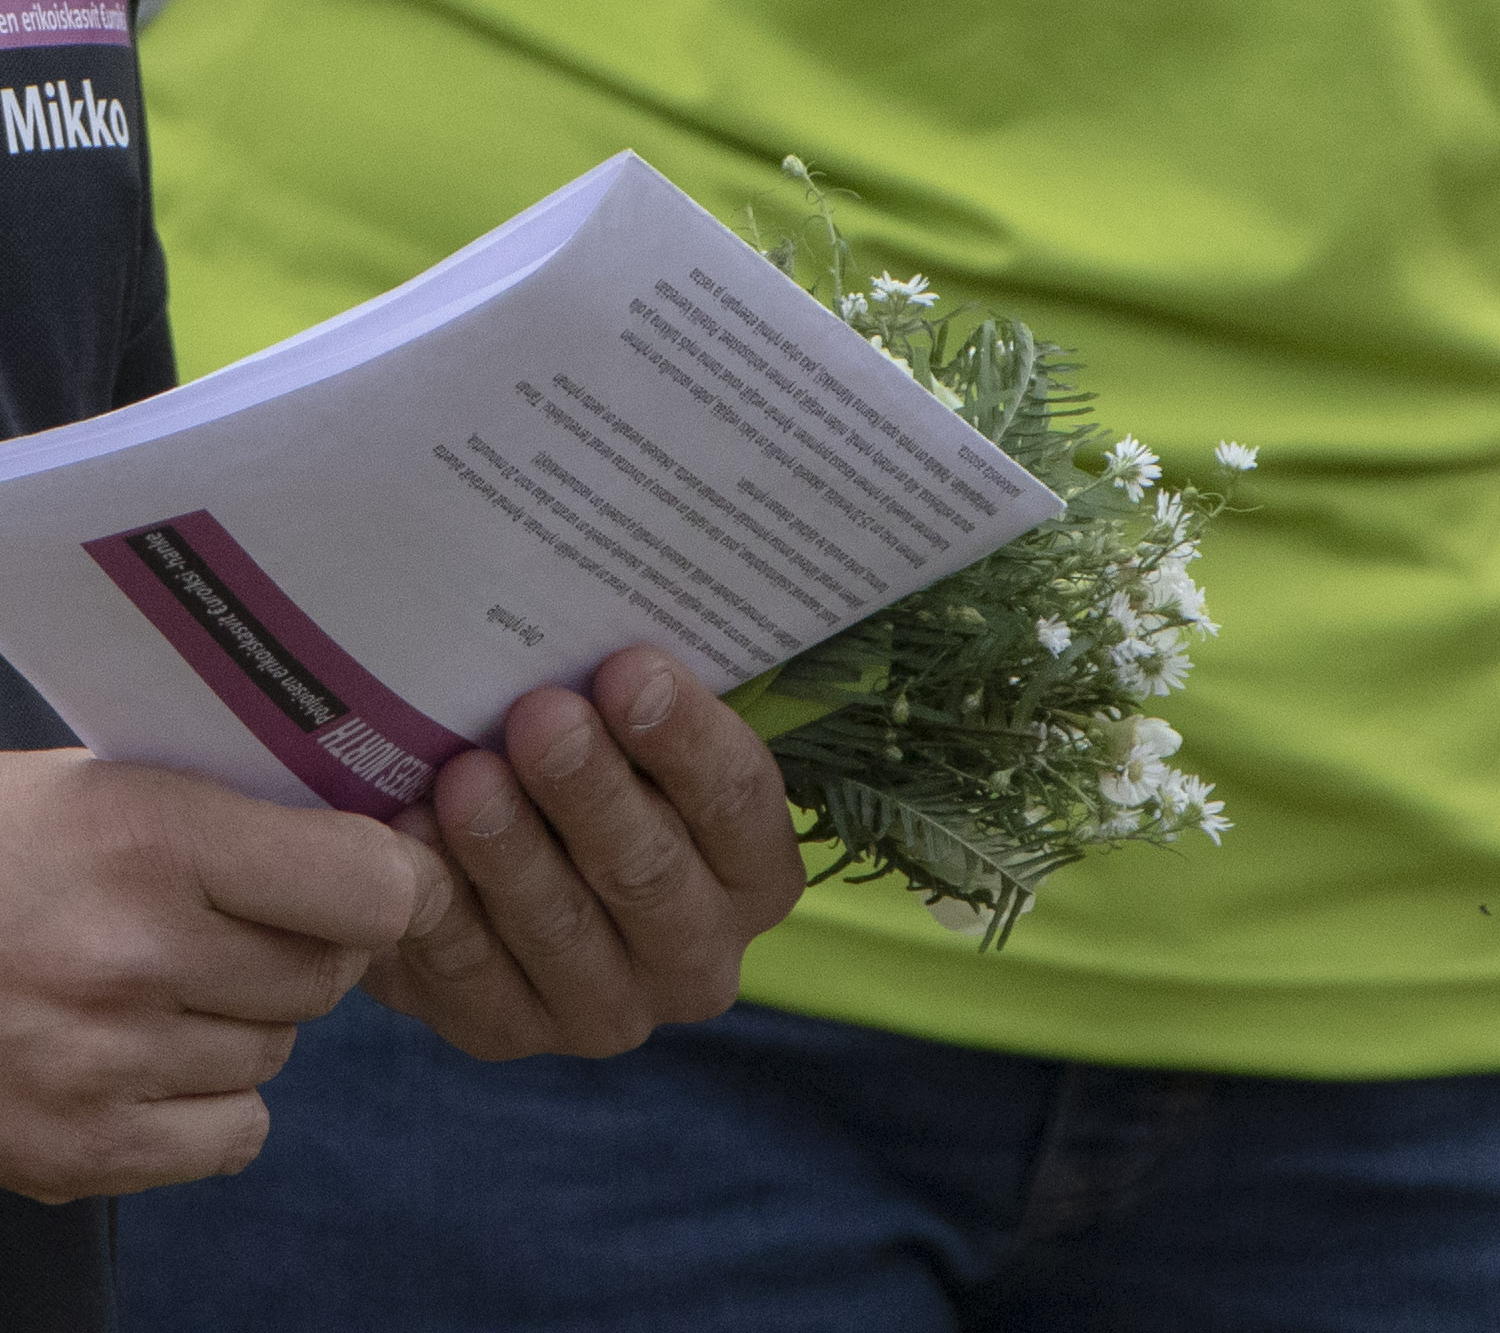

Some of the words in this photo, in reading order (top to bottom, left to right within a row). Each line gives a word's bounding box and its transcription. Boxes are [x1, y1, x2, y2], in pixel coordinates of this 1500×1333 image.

[22, 2, 101, 32] erikoiskasvit
[0, 79, 129, 155] Mikko
[145, 532, 187, 570] -hanke
[218, 613, 289, 678] erikoiskasvit
[519, 625, 544, 647] Ohje
[282, 677, 335, 725] Pohjoisen
[317, 717, 406, 782] NORTH
